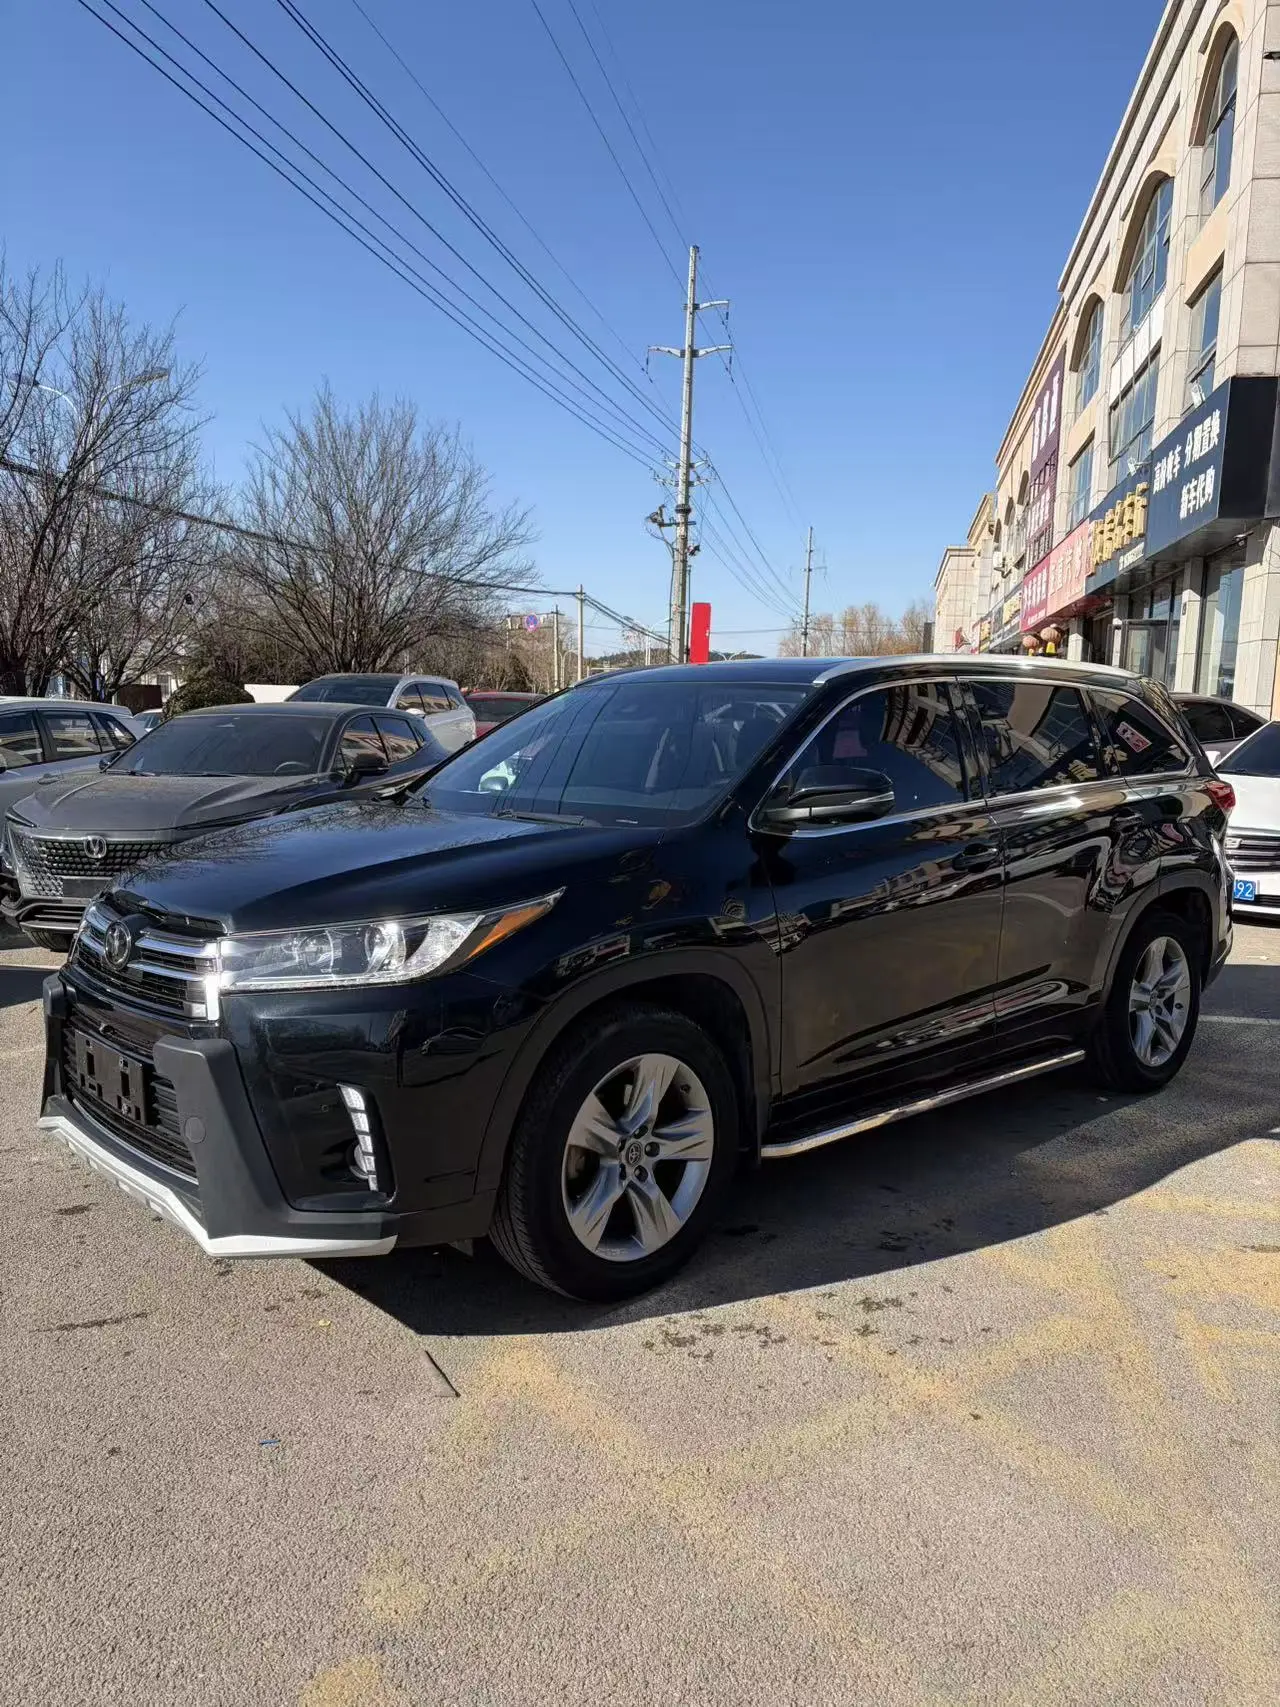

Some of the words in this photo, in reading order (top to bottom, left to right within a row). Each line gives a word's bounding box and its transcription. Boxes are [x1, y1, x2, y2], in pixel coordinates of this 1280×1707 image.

[1184, 408, 1221, 468] 分期置换
[1179, 464, 1216, 521] 新车代购
[1237, 881, 1253, 898] 92
